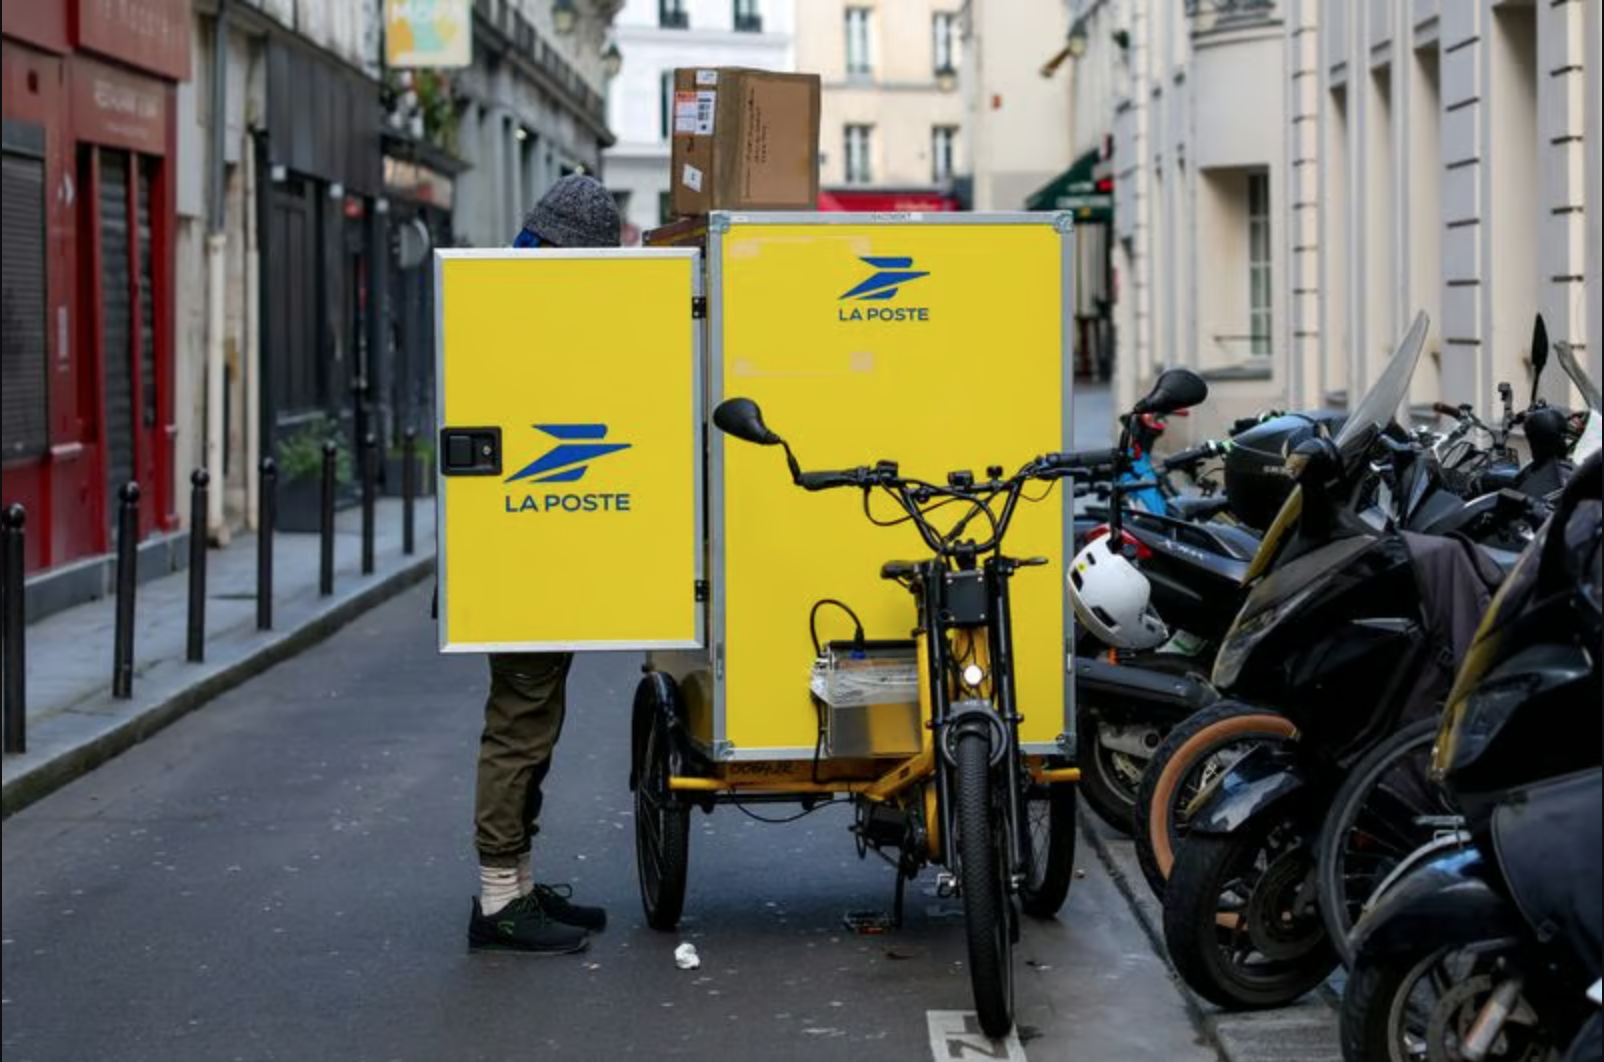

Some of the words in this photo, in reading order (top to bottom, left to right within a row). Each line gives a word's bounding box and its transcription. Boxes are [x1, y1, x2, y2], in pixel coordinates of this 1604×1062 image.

[838, 307, 863, 322] LA
[866, 307, 930, 322] POSTE
[505, 494, 539, 513] LA
[544, 492, 631, 513] POSTE
